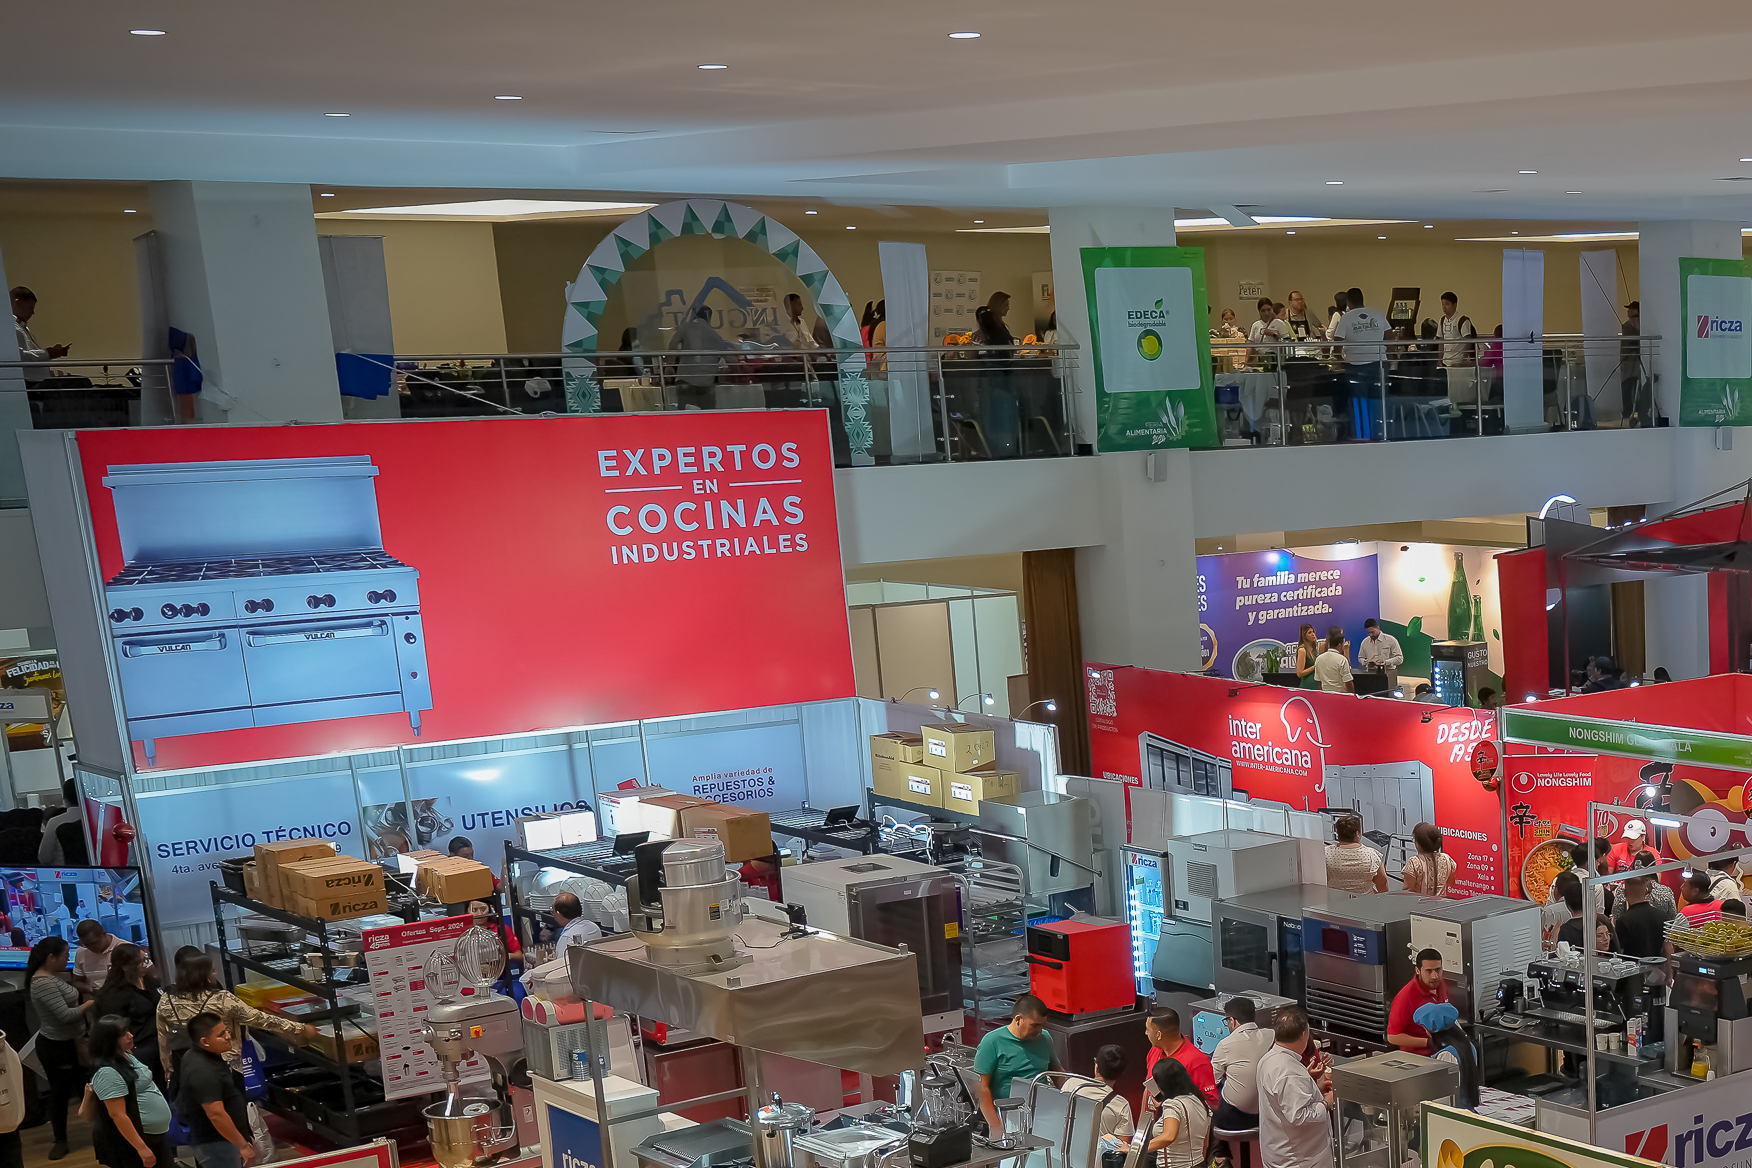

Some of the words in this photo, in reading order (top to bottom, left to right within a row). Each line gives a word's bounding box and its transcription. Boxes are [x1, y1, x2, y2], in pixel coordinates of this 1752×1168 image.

[1127, 310, 1166, 320] EDECA
[1710, 315, 1743, 332] ricza
[1126, 427, 1168, 437] ALIMENTARIA
[597, 441, 801, 478] EXPERTOS
[692, 478, 720, 495] EN
[606, 495, 805, 537] COCINAS
[610, 533, 809, 566] INDUSTRIALES
[1236, 574, 1251, 591] Tu
[1252, 570, 1295, 589] familia
[1297, 567, 1341, 584] merece
[1236, 591, 1279, 610] pureza
[1280, 584, 1343, 604] certificada
[1247, 610, 1257, 626] y
[1258, 602, 1333, 623] garantizada.
[303, 631, 337, 643] VULCAN
[156, 642, 192, 654] VULCAN
[1228, 714, 1262, 740] inter
[1437, 719, 1493, 745] DESDE
[1569, 726, 1624, 745] NONGSHIM
[1231, 738, 1312, 769] americana
[691, 772, 722, 783] Amplia
[722, 768, 761, 780] variedad
[763, 766, 773, 776] de
[1236, 760, 1309, 777] WWW.INTER-AMERICANA.COM
[693, 776, 766, 796] REPUESTOS
[766, 775, 776, 786] &
[1103, 770, 1140, 785] UBICACIONES
[1537, 777, 1593, 788] NONGSHIM
[1509, 801, 1538, 840] 辛
[157, 832, 256, 860] SERVICIO
[1137, 854, 1158, 868] ricza
[1467, 851, 1481, 862] Zona
[1481, 853, 1489, 862] 17
[1466, 862, 1481, 872] Zona
[1481, 863, 1489, 872] 09
[325, 873, 363, 889] ricza
[342, 900, 379, 914] ricza
[401, 928, 427, 938] Ofertas
[429, 925, 448, 934] Sept.
[448, 921, 464, 931] 2024
[368, 934, 390, 943] ricza
